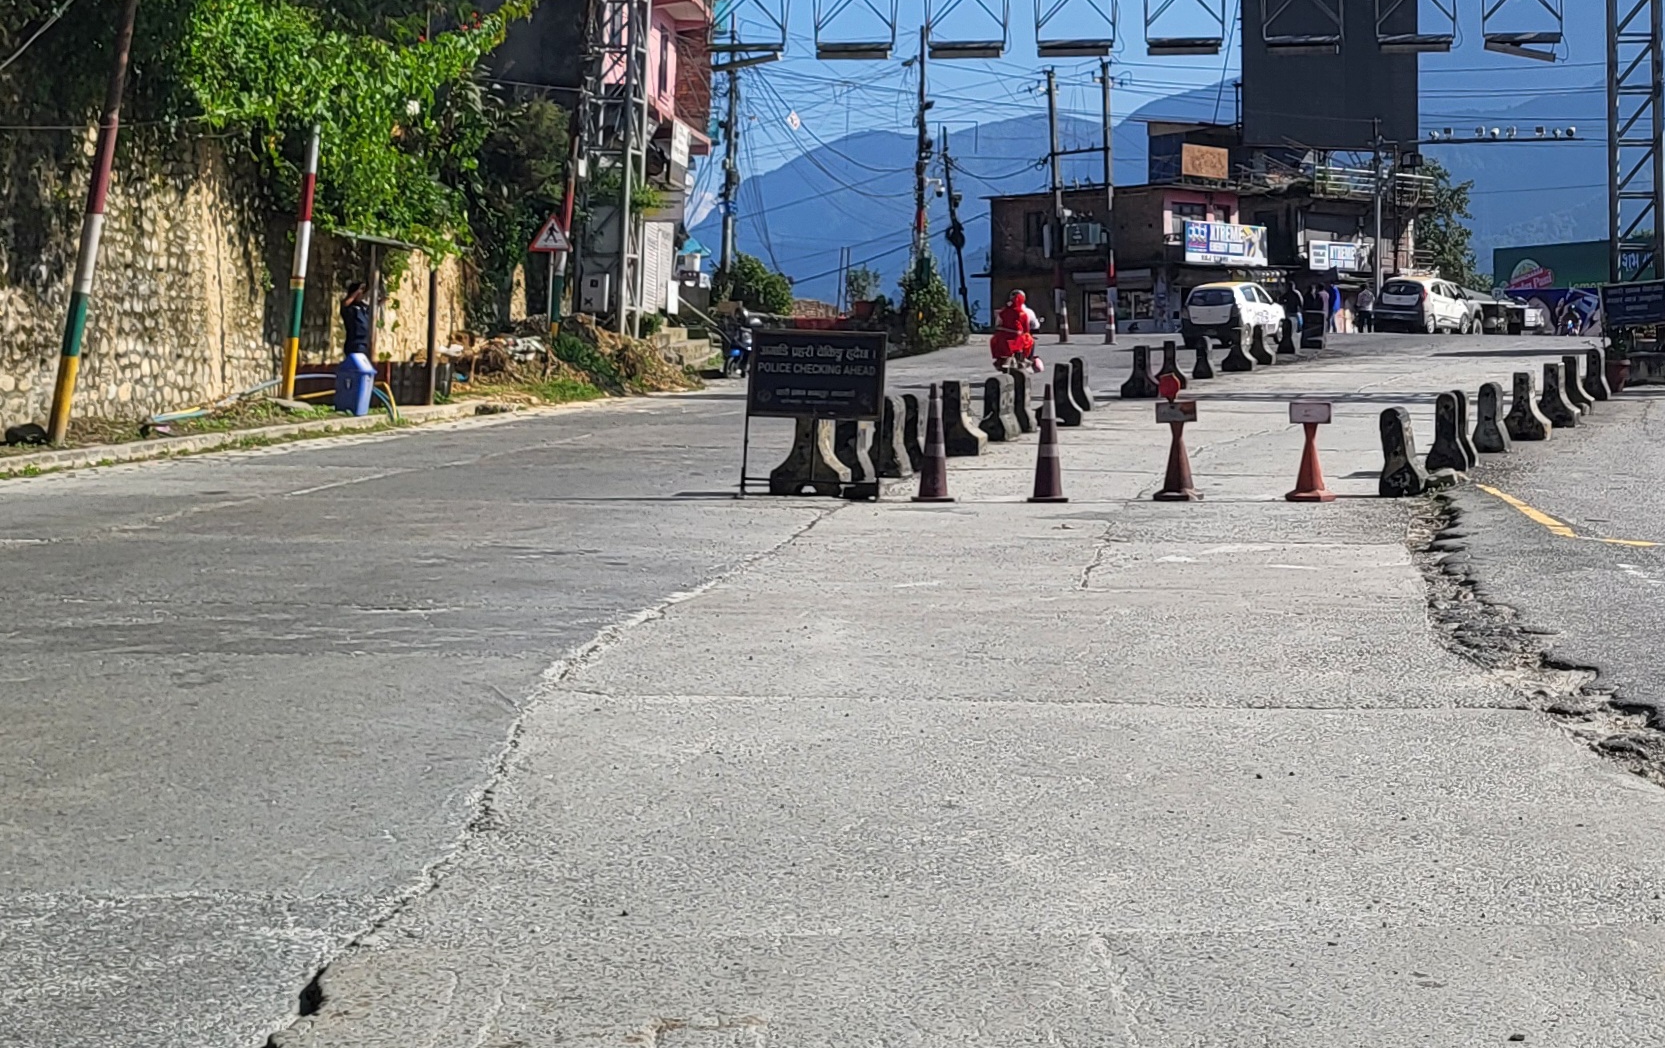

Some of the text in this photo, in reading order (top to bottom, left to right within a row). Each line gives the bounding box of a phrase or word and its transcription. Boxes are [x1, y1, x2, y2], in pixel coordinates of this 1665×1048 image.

[758, 362, 876, 376] POLICE CHECKING AHEAD
